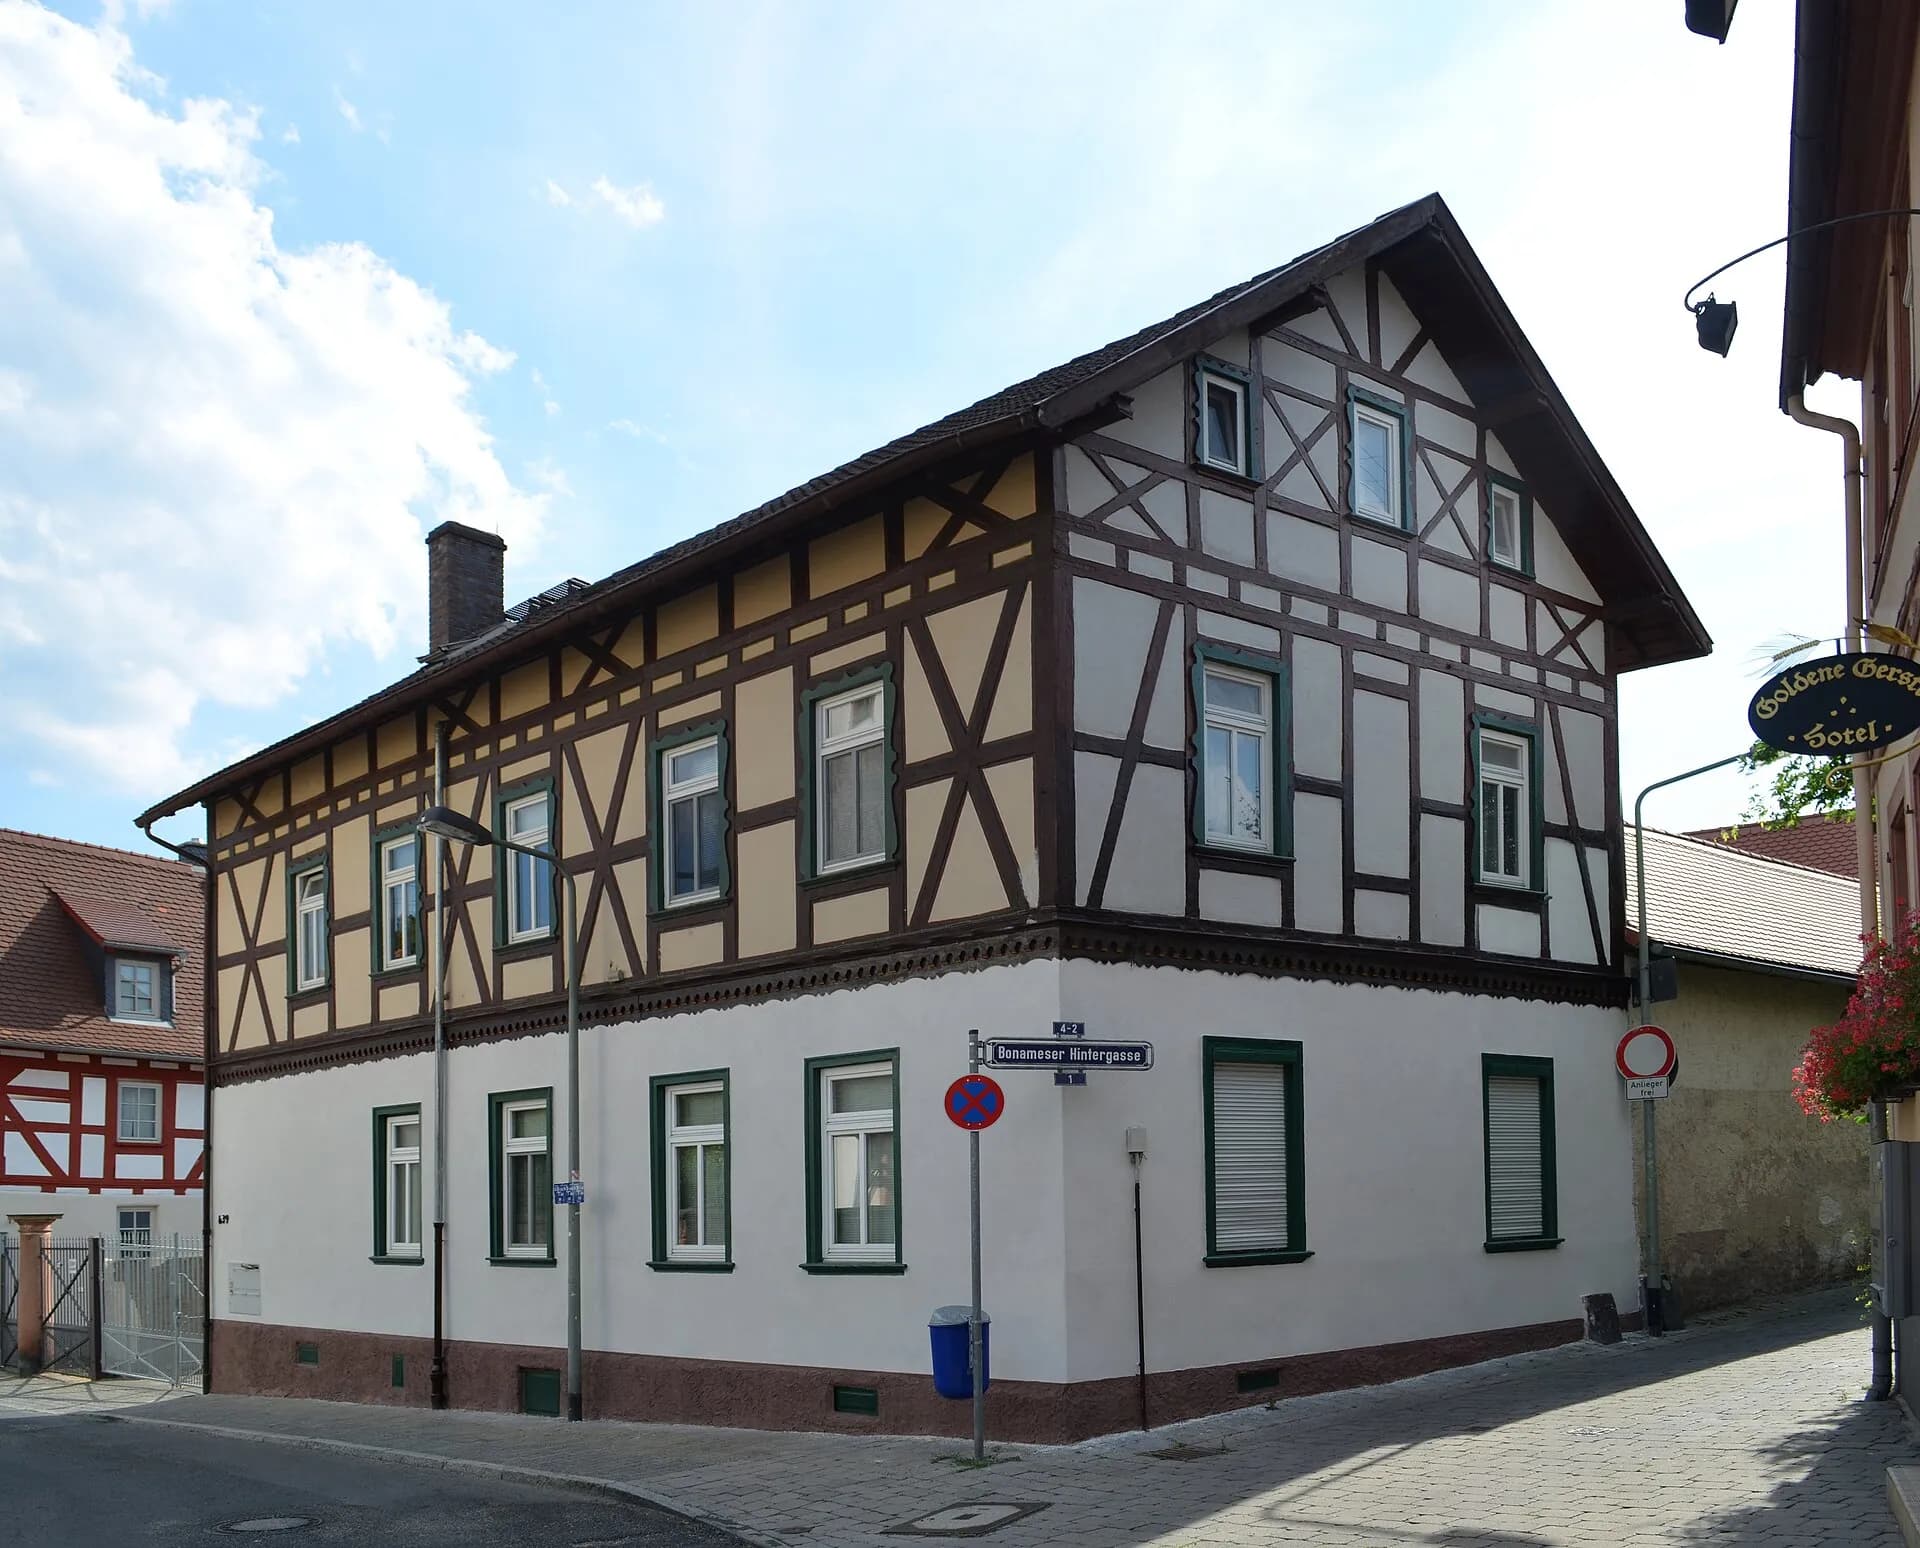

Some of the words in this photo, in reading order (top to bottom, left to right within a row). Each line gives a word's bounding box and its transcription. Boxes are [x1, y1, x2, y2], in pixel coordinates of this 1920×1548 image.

[1755, 663, 1846, 720] Goldene
[1803, 719, 1879, 749] Hotel
[1060, 1023, 1078, 1034] 4-2
[998, 1045, 1065, 1060] Bonameser
[1070, 1047, 1141, 1064] Hintergasse
[1630, 1080, 1663, 1089] Anlieger
[1640, 1089, 1655, 1097] frei
